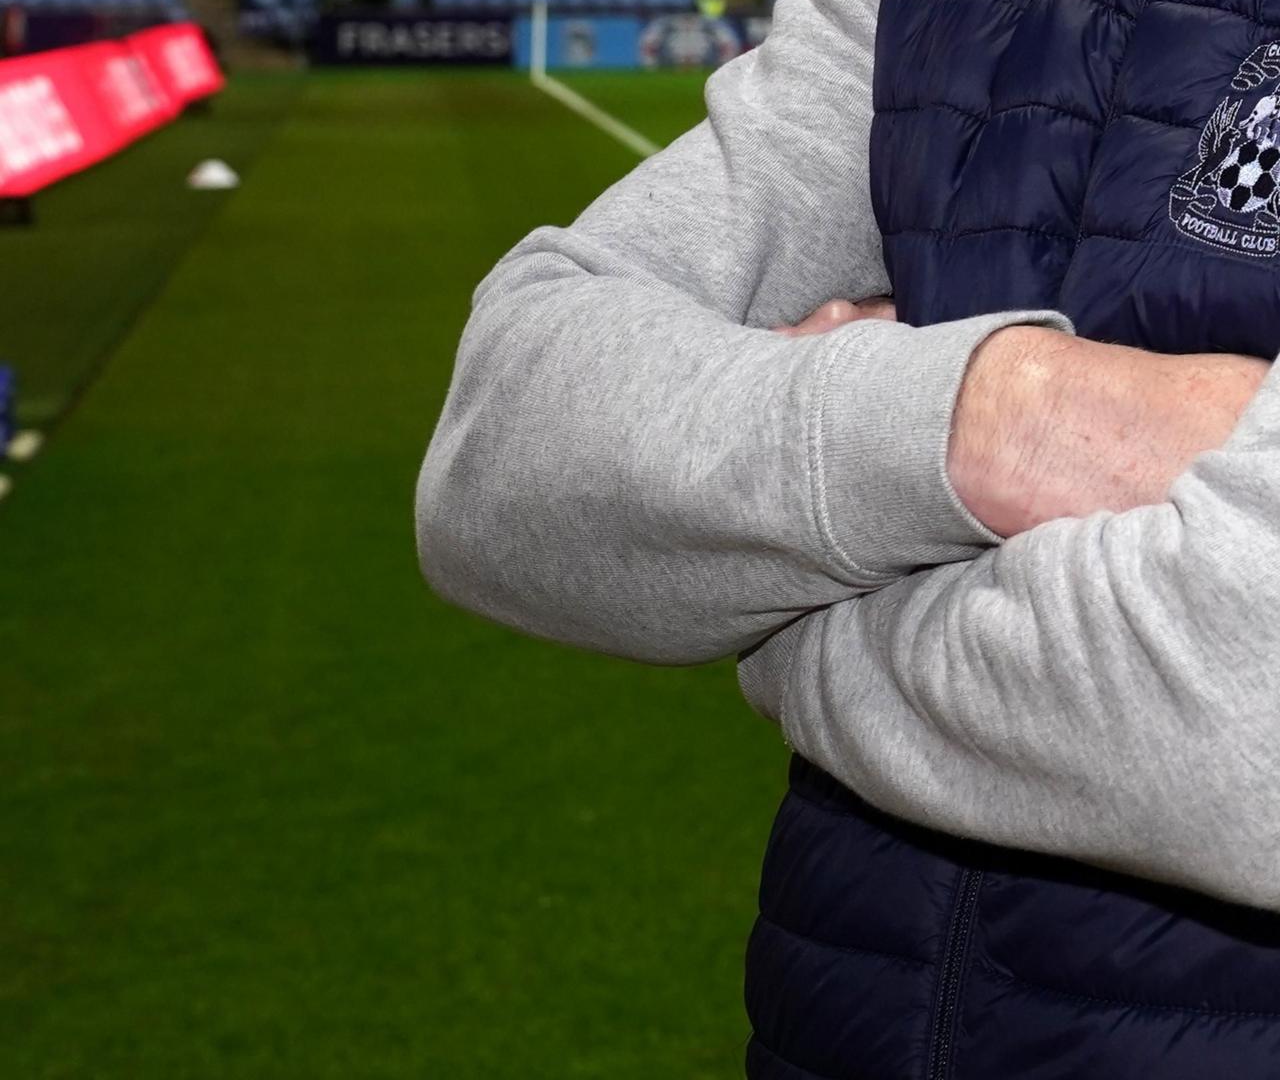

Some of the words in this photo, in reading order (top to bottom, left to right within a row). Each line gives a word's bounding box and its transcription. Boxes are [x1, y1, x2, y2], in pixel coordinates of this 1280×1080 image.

[337, 21, 508, 58] FRASERS
[1181, 213, 1238, 245] FOOTBALL
[1241, 234, 1276, 251] CLUB
